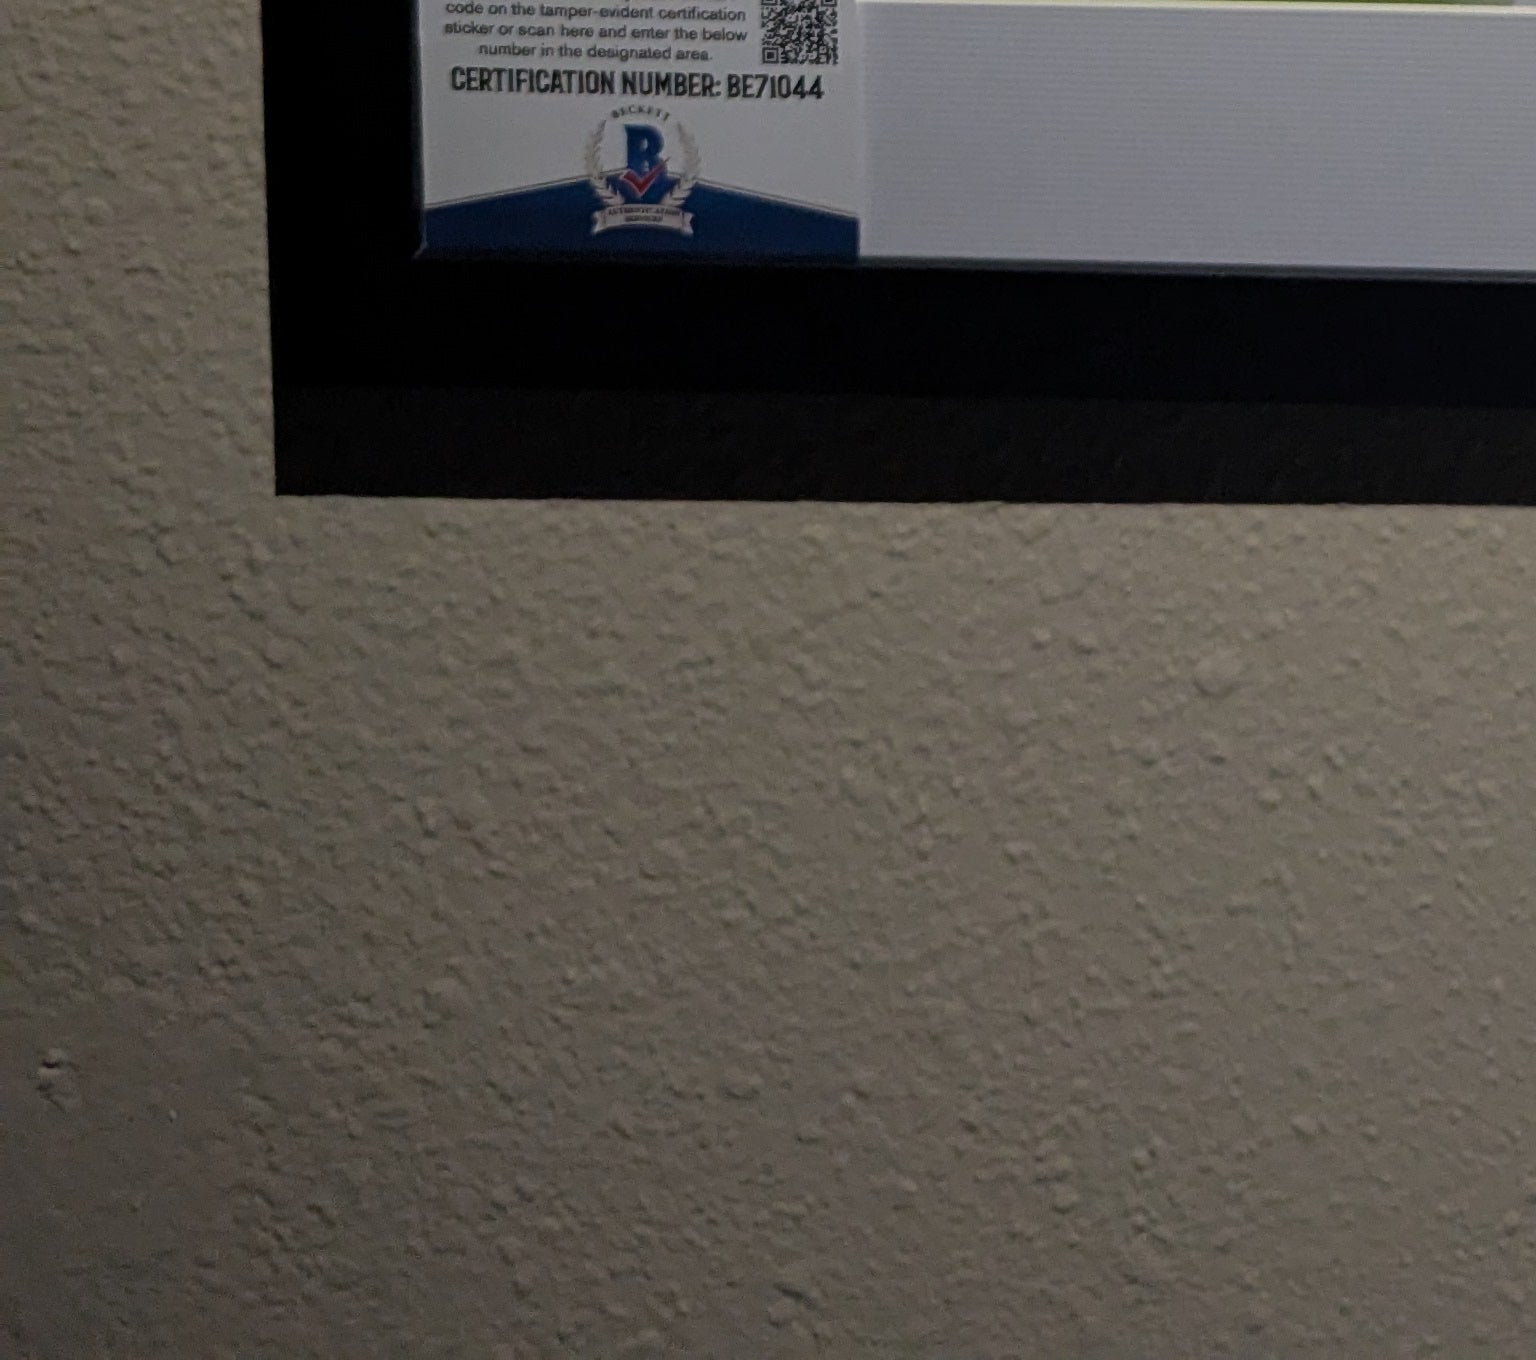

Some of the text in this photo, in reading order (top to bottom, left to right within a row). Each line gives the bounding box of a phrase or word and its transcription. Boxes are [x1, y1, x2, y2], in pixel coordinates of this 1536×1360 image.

[446, 1, 746, 21] code on the tamper-evident certification
[444, 22, 747, 41] sticker or scan here and enter the below
[478, 42, 713, 62] number in the designated area.
[451, 65, 825, 100] CERTIFICATION NUMBER: BE71044
